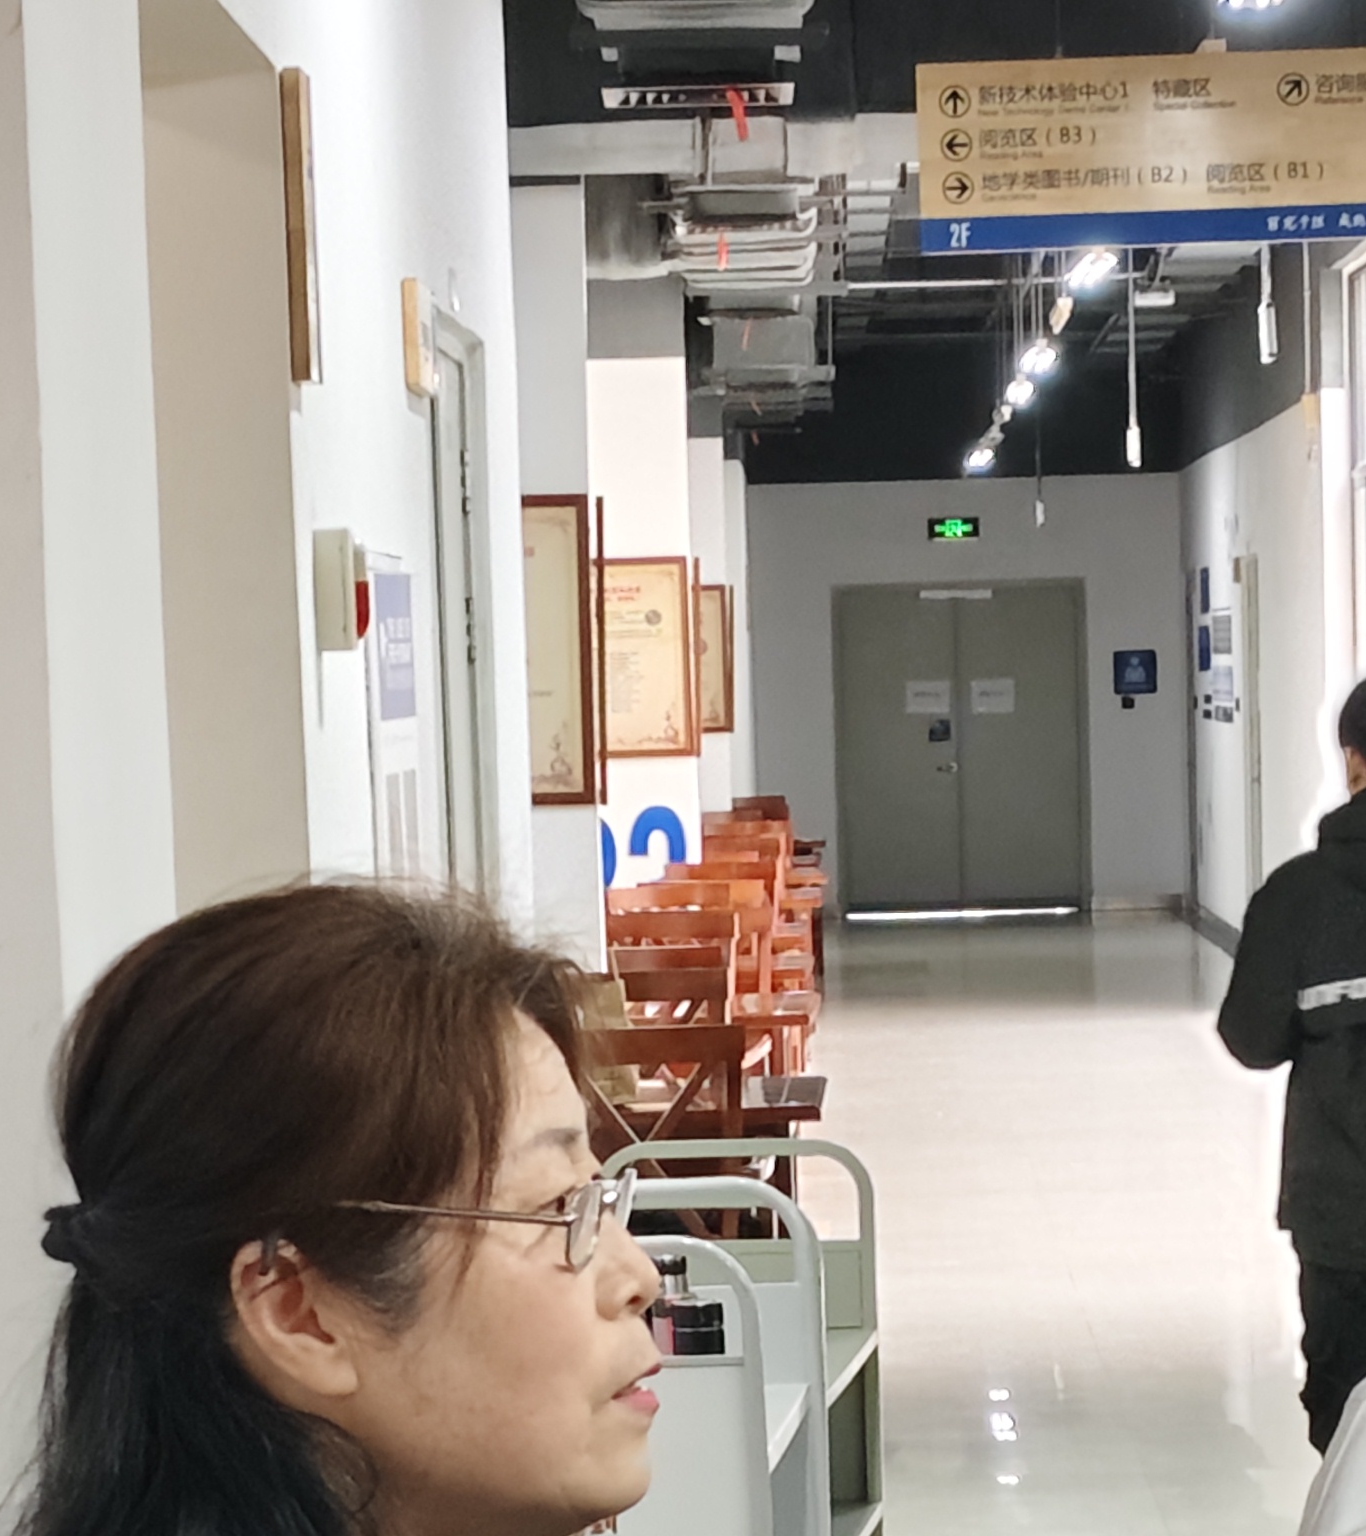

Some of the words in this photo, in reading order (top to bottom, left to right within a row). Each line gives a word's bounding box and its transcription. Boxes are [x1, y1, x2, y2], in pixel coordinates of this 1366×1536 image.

[978, 80, 1129, 105] 新技术体验中心1
[1152, 77, 1212, 99] 特藏区
[949, 221, 972, 249] 2F
